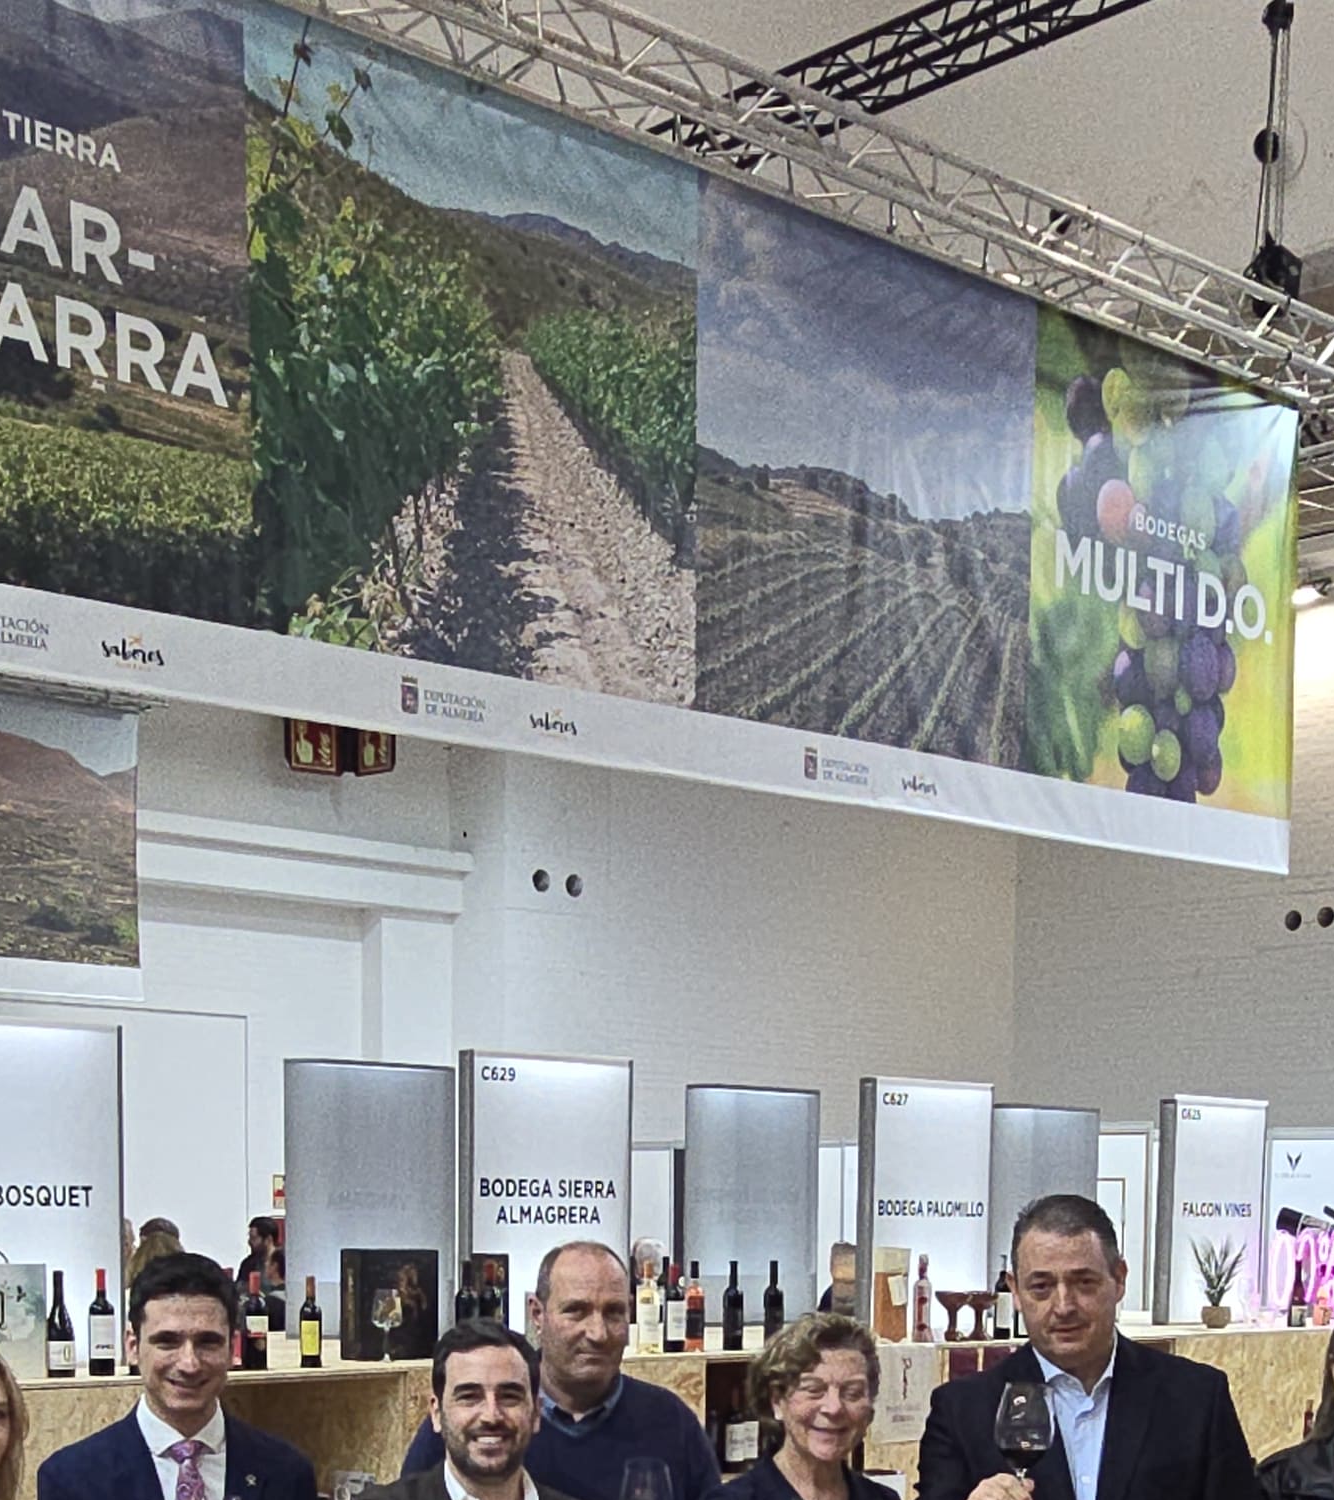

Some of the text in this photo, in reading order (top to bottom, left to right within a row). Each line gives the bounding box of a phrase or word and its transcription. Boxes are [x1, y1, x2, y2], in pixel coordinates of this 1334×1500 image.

[1, 110, 122, 173] TIERRA
[1134, 511, 1208, 551] BODEGAS
[1055, 528, 1273, 645] MULTI D.O.
[480, 1065, 516, 1083] C629
[479, 1176, 617, 1200] BODEGA SIERRA
[496, 1204, 601, 1226] ALMAGRERA
[878, 1199, 923, 1217] BODEGA
